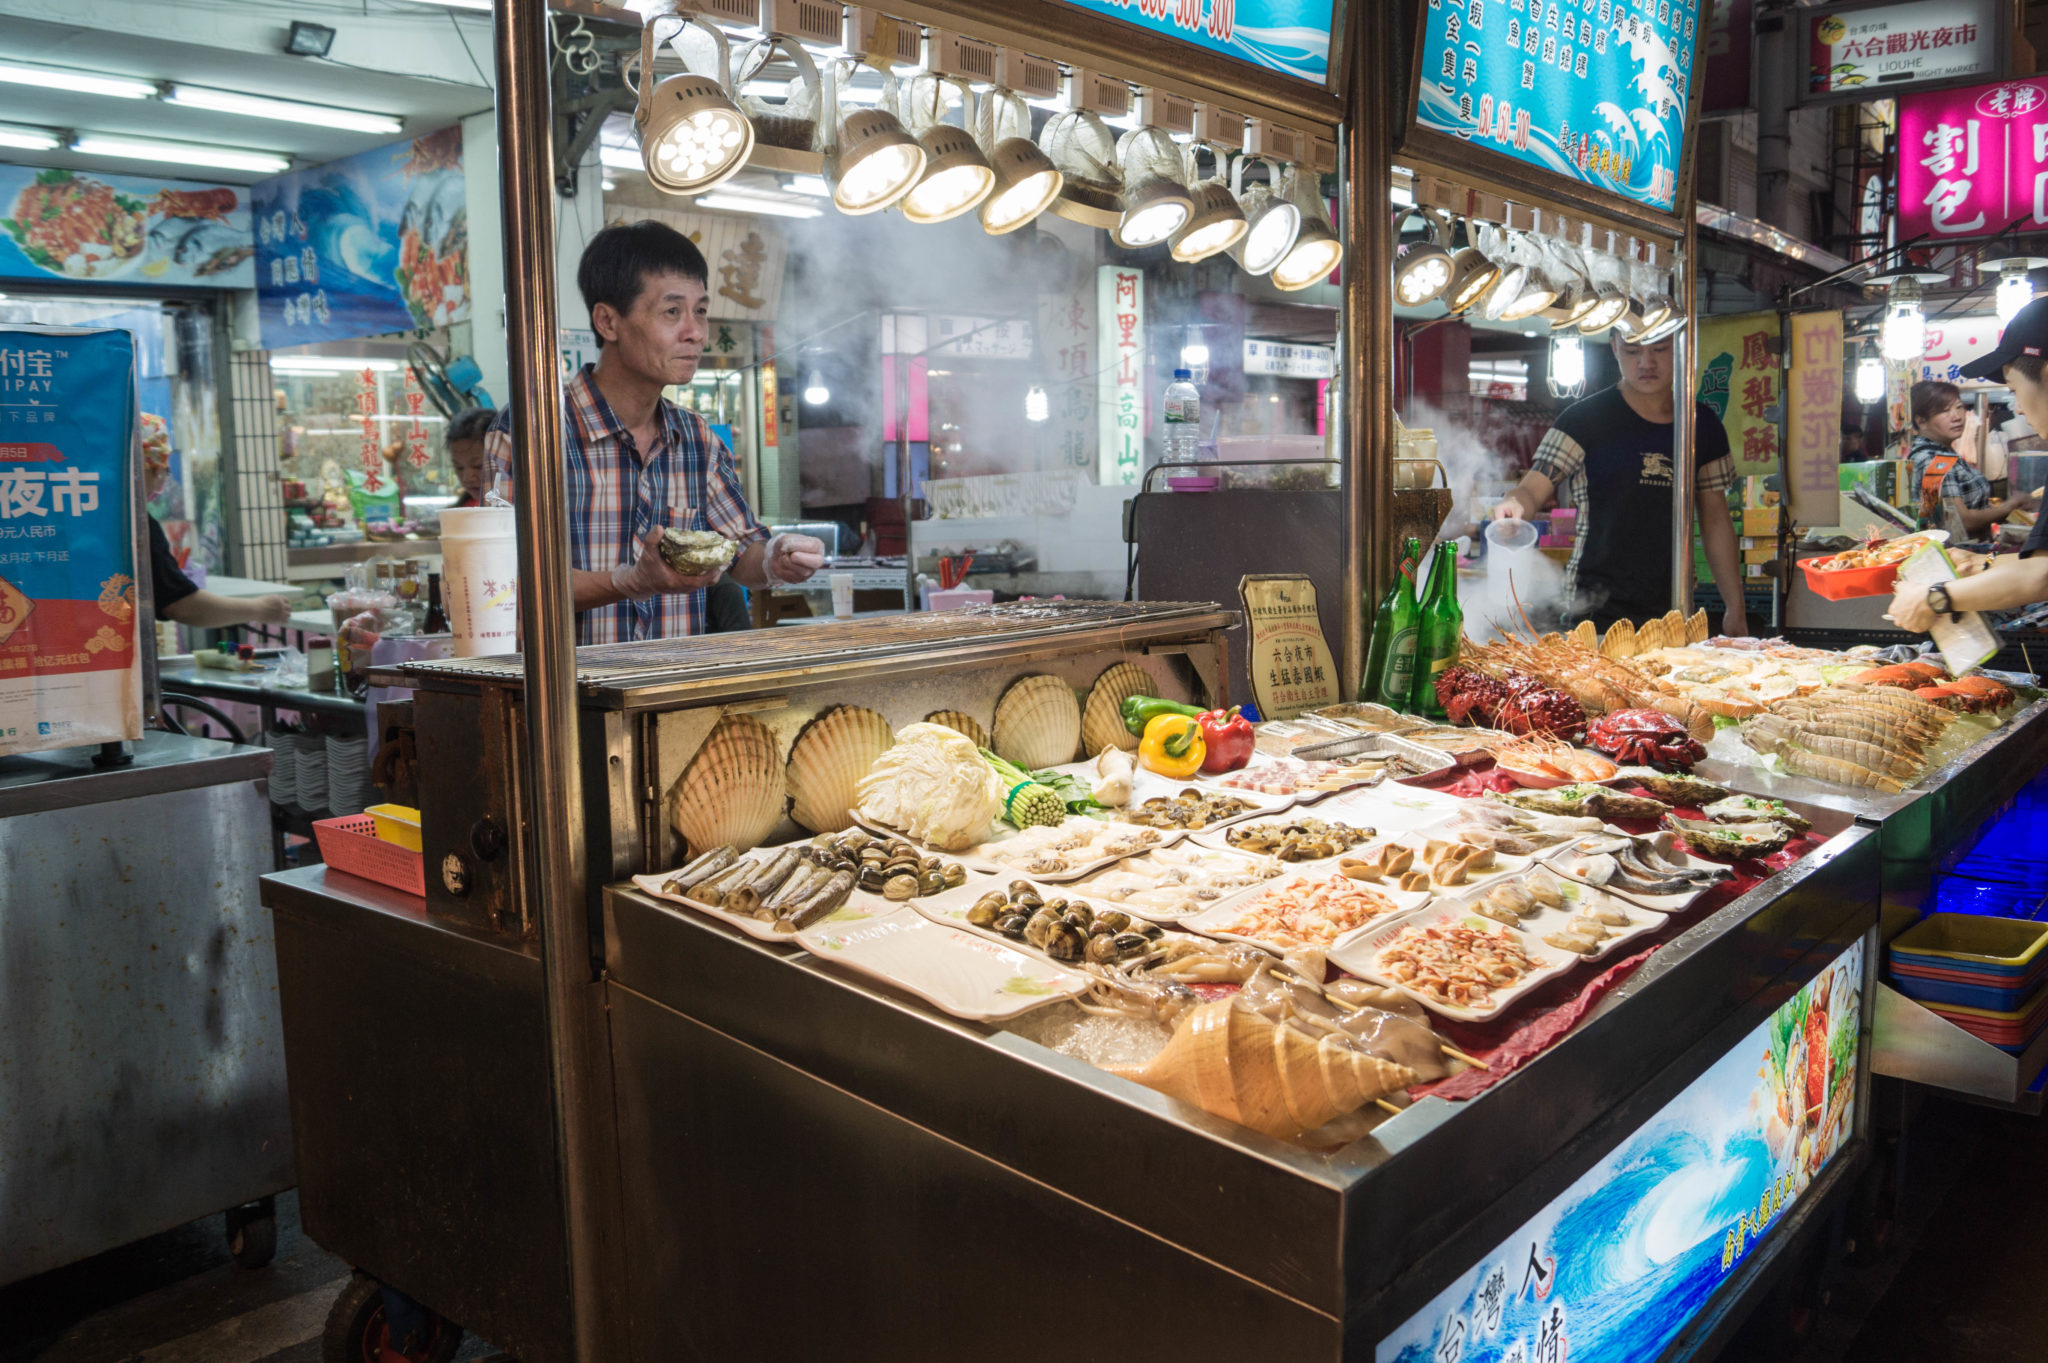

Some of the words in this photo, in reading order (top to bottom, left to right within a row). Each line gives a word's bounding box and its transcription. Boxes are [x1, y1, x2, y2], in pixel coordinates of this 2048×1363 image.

[1841, 23, 1978, 60] 六合觀光夜市
[1878, 57, 1923, 73] LIOUHE
[1915, 68, 1943, 78] NIGHT
[1945, 63, 1980, 75] MARKET
[1479, 96, 1493, 136] 150
[1989, 86, 2037, 113] 老牌
[1497, 104, 1510, 143] 150
[1514, 111, 1530, 150] 300
[1920, 120, 1986, 233] 割包
[1739, 330, 1778, 463] 鳳梨酥
[355, 367, 385, 493] 凍頂烏龍茶
[1272, 645, 1314, 662] 六合夜市
[1270, 666, 1325, 687] 生猛泰國蝦
[1439, 1242, 1548, 1363] 台灣人
